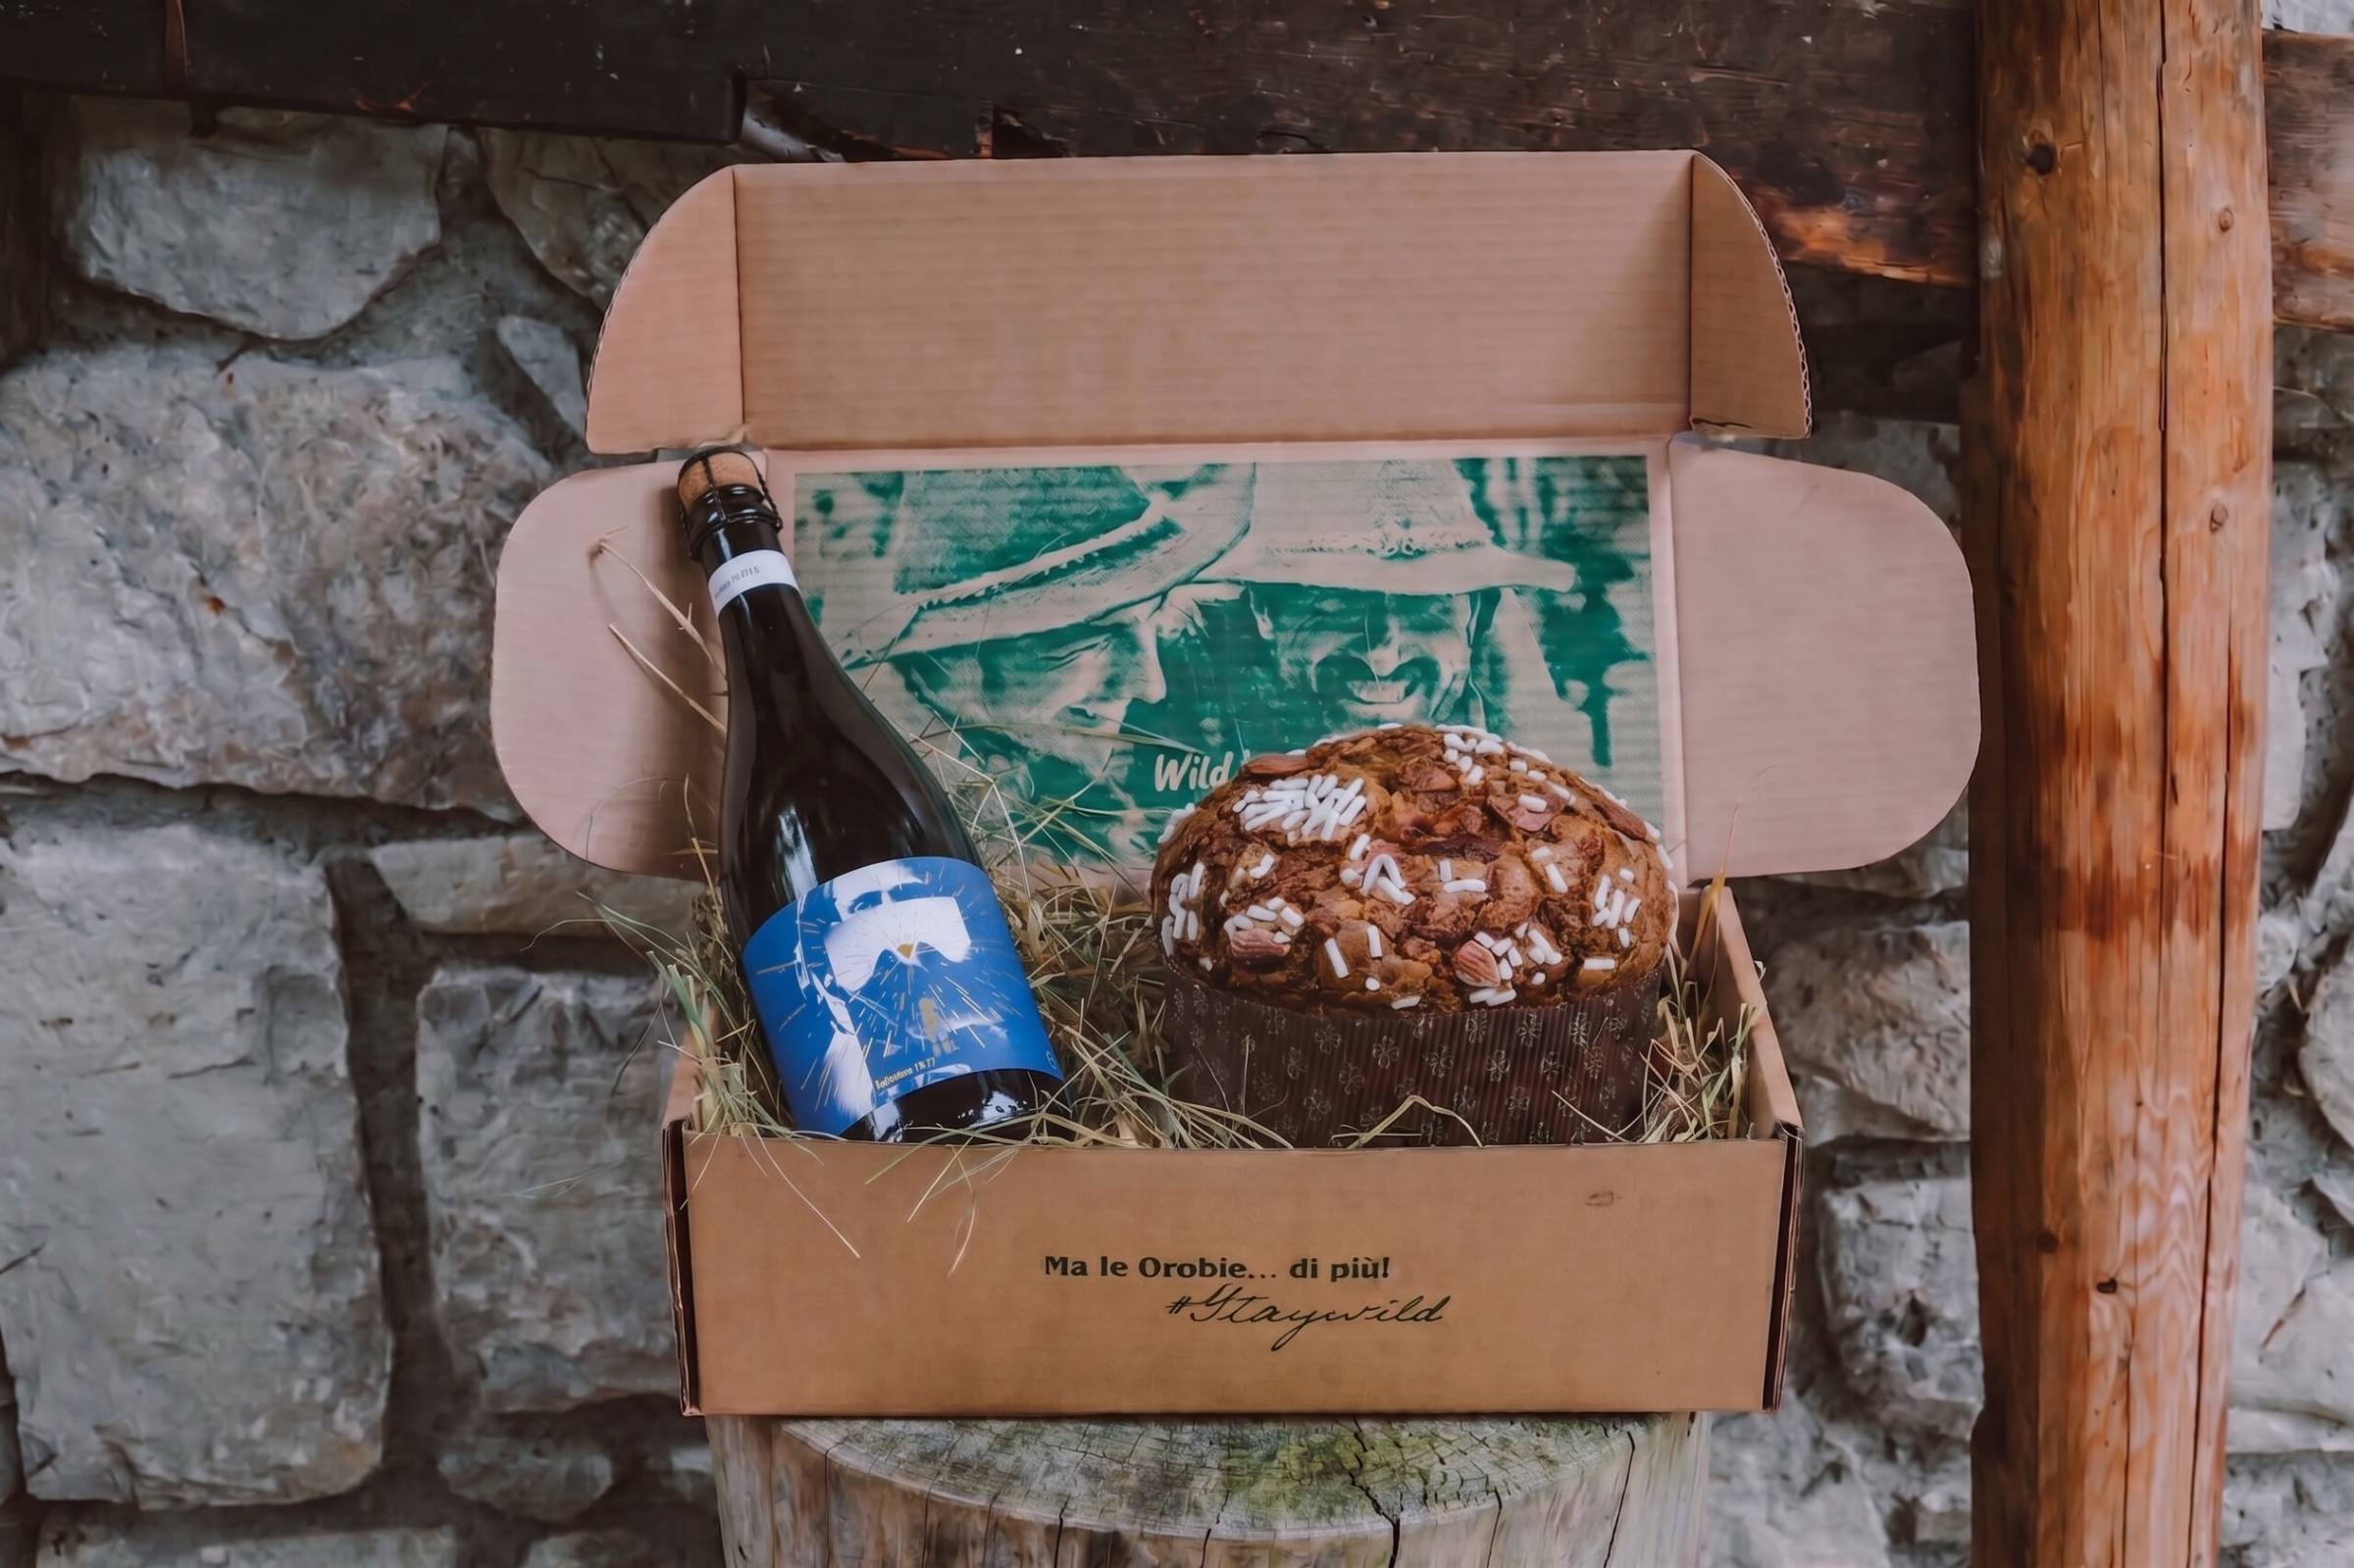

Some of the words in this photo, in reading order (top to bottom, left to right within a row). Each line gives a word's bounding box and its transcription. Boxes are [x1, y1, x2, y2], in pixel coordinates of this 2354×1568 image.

[1153, 750, 1234, 792] Wild
[1045, 1255, 1088, 1276] Ma
[1100, 1255, 1128, 1277] le
[1138, 1256, 1277, 1279] Orobie...
[1289, 1257, 1318, 1279] di
[1330, 1256, 1390, 1283] più!
